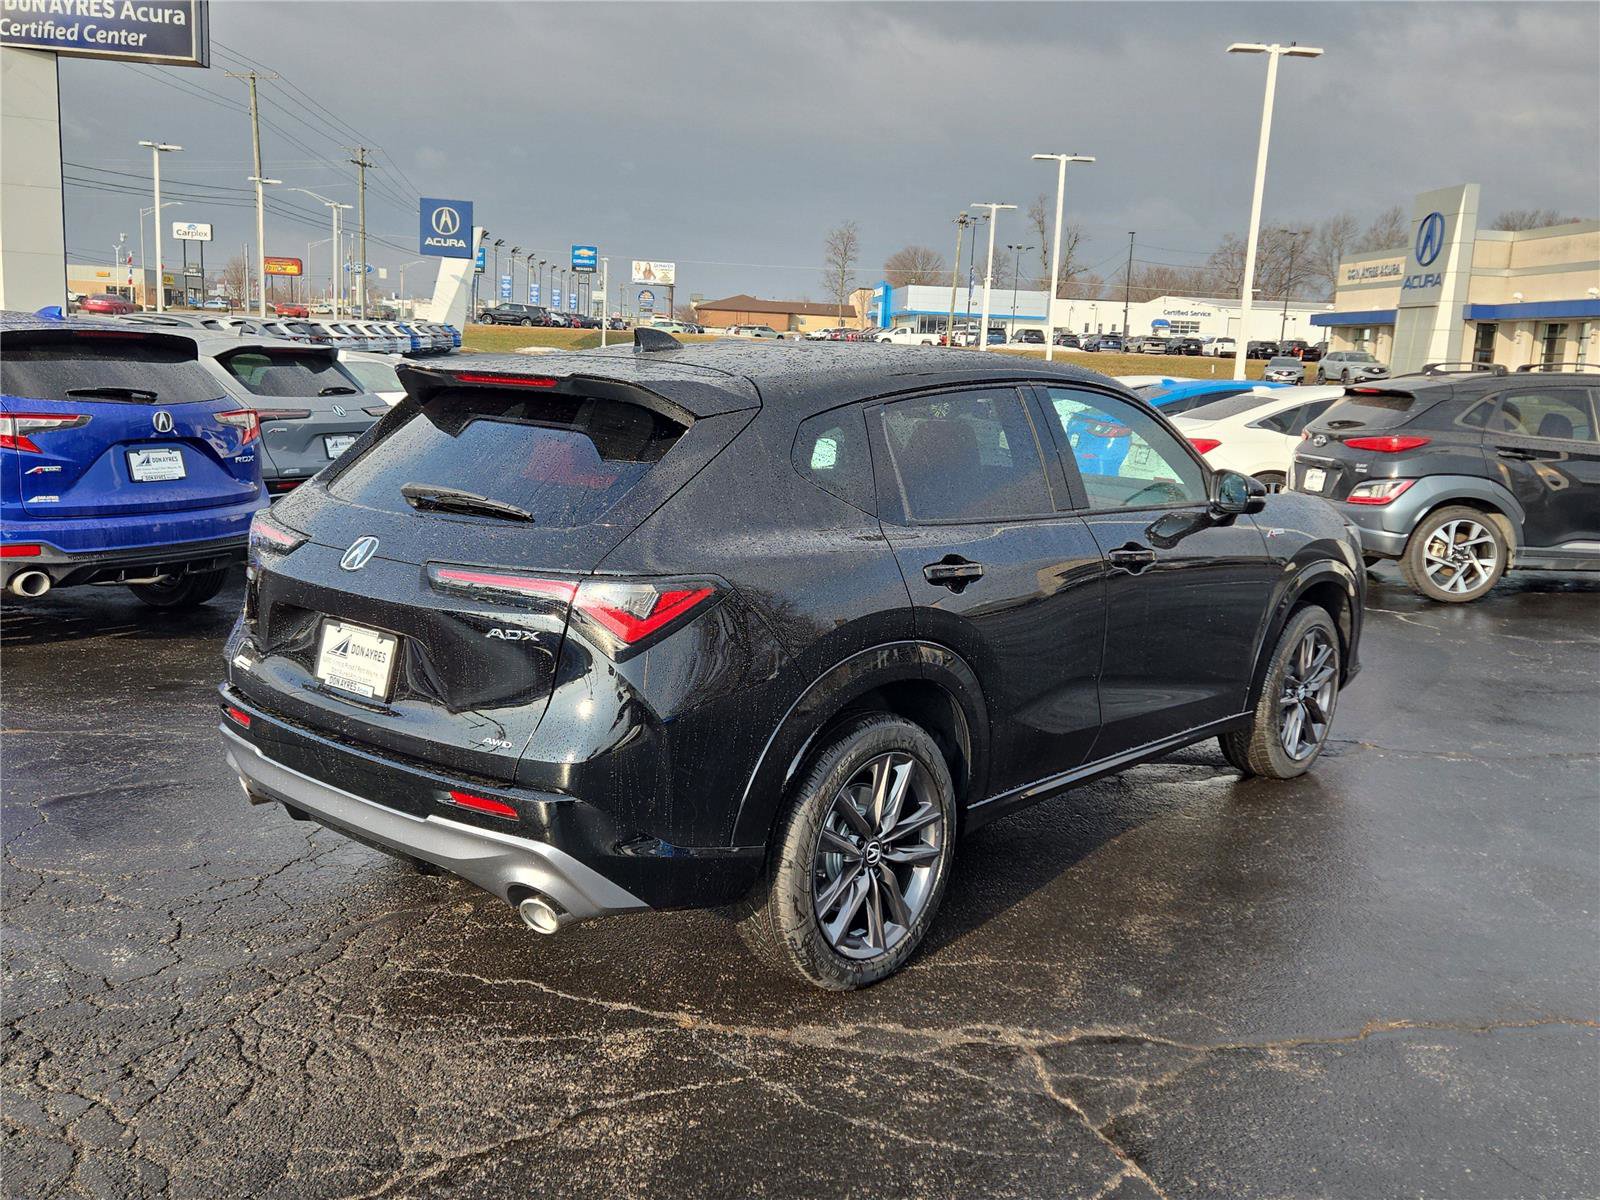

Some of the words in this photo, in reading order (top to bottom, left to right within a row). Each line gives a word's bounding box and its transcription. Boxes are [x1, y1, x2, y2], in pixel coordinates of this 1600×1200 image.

[49, 0, 115, 19] AYRES
[119, 0, 186, 26] Acura
[0, 18, 79, 41] Certified
[83, 24, 147, 47] Center
[176, 229, 208, 239] Carplex
[424, 236, 466, 248] ACURA
[1402, 273, 1442, 290] ACURA
[235, 455, 254, 463] RDX
[485, 628, 540, 641] ADX
[350, 643, 365, 657] DON
[365, 647, 387, 664] AYRES
[328, 675, 340, 686] DON
[340, 677, 358, 692] AYRES
[482, 737, 512, 749] AWD
